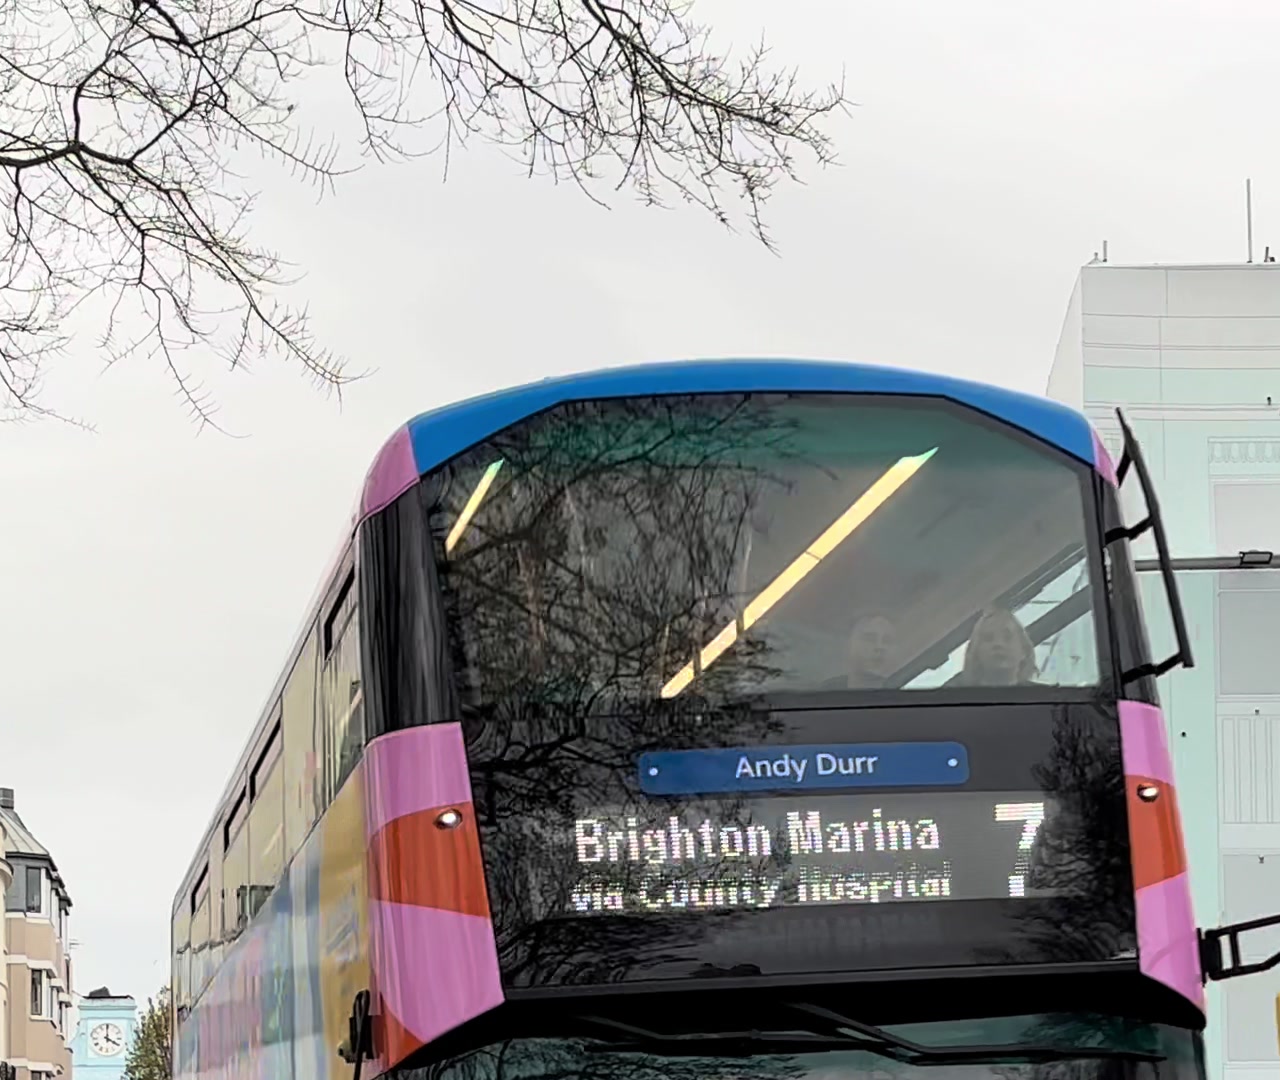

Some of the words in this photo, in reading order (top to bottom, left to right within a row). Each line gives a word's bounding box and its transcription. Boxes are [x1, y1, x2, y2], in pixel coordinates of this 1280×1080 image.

[735, 753, 807, 783] Andy
[816, 753, 878, 775] Durr
[575, 816, 771, 864] Brighton
[787, 808, 940, 854] Marina
[995, 802, 1044, 897] 7
